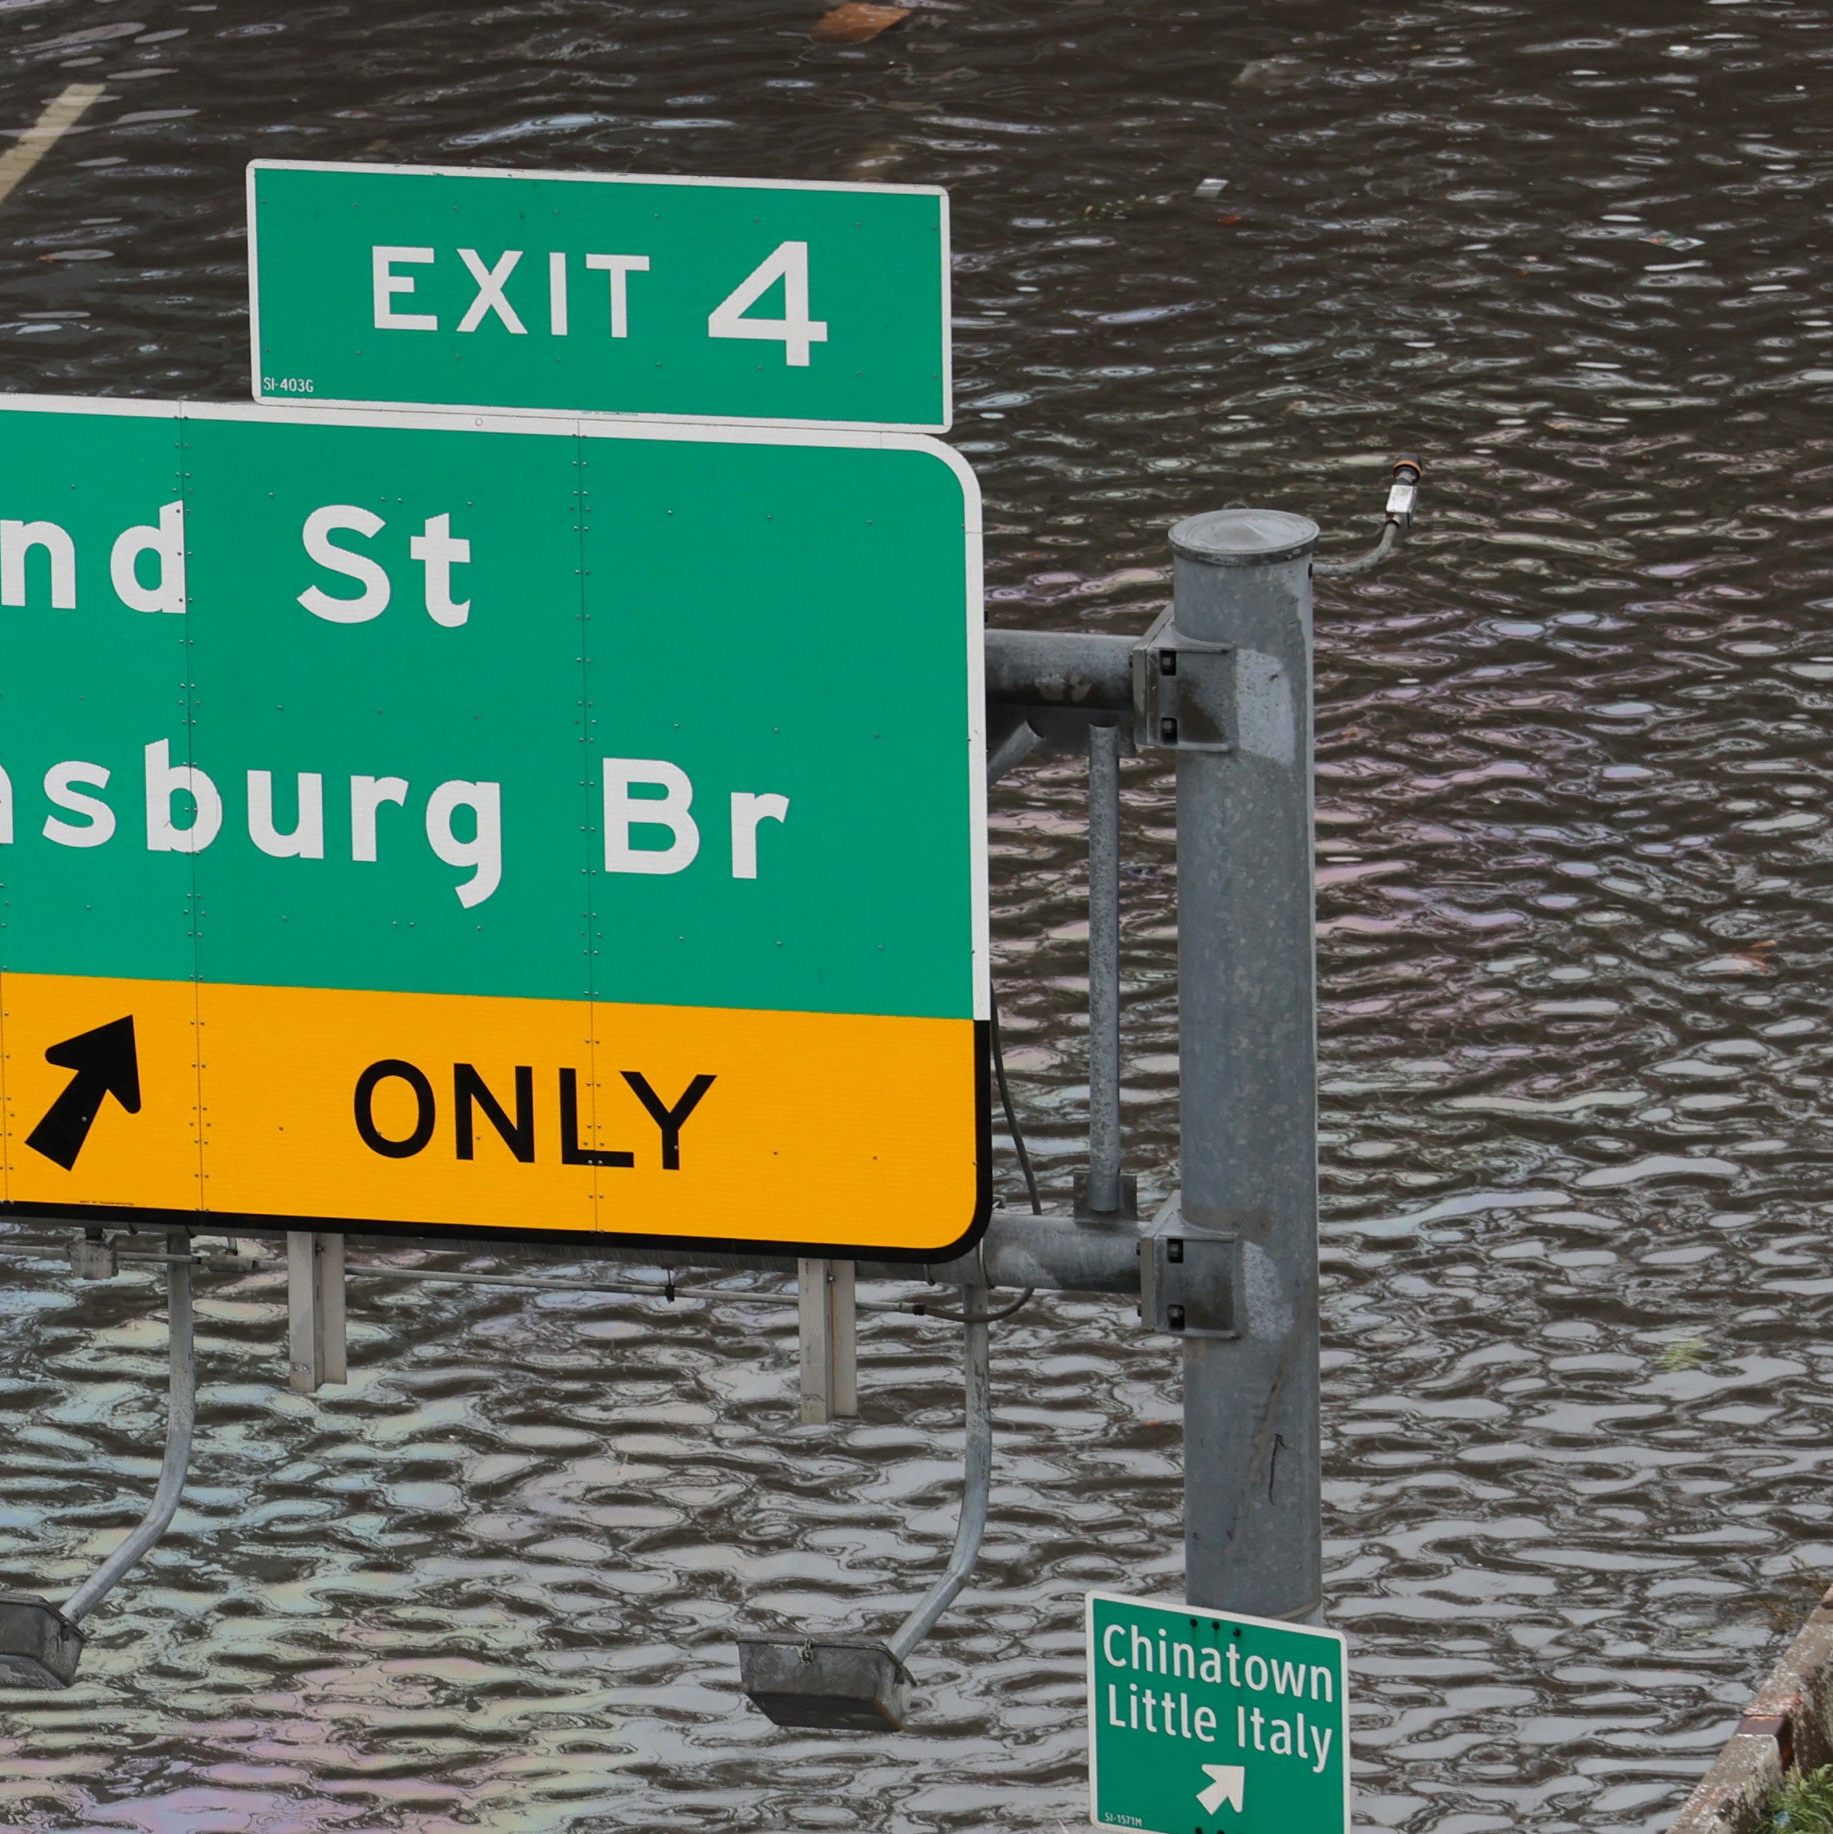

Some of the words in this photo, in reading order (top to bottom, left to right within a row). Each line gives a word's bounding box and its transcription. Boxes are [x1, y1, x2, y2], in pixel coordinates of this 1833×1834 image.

[373, 246, 650, 338] EXIT
[709, 241, 828, 367] 4
[296, 505, 471, 628] St
[602, 758, 790, 879] Br
[354, 1059, 717, 1170] ONLY
[1102, 1623, 1334, 1704] Chinatown
[1107, 1684, 1217, 1742] Little
[1237, 1705, 1334, 1774] Italy
